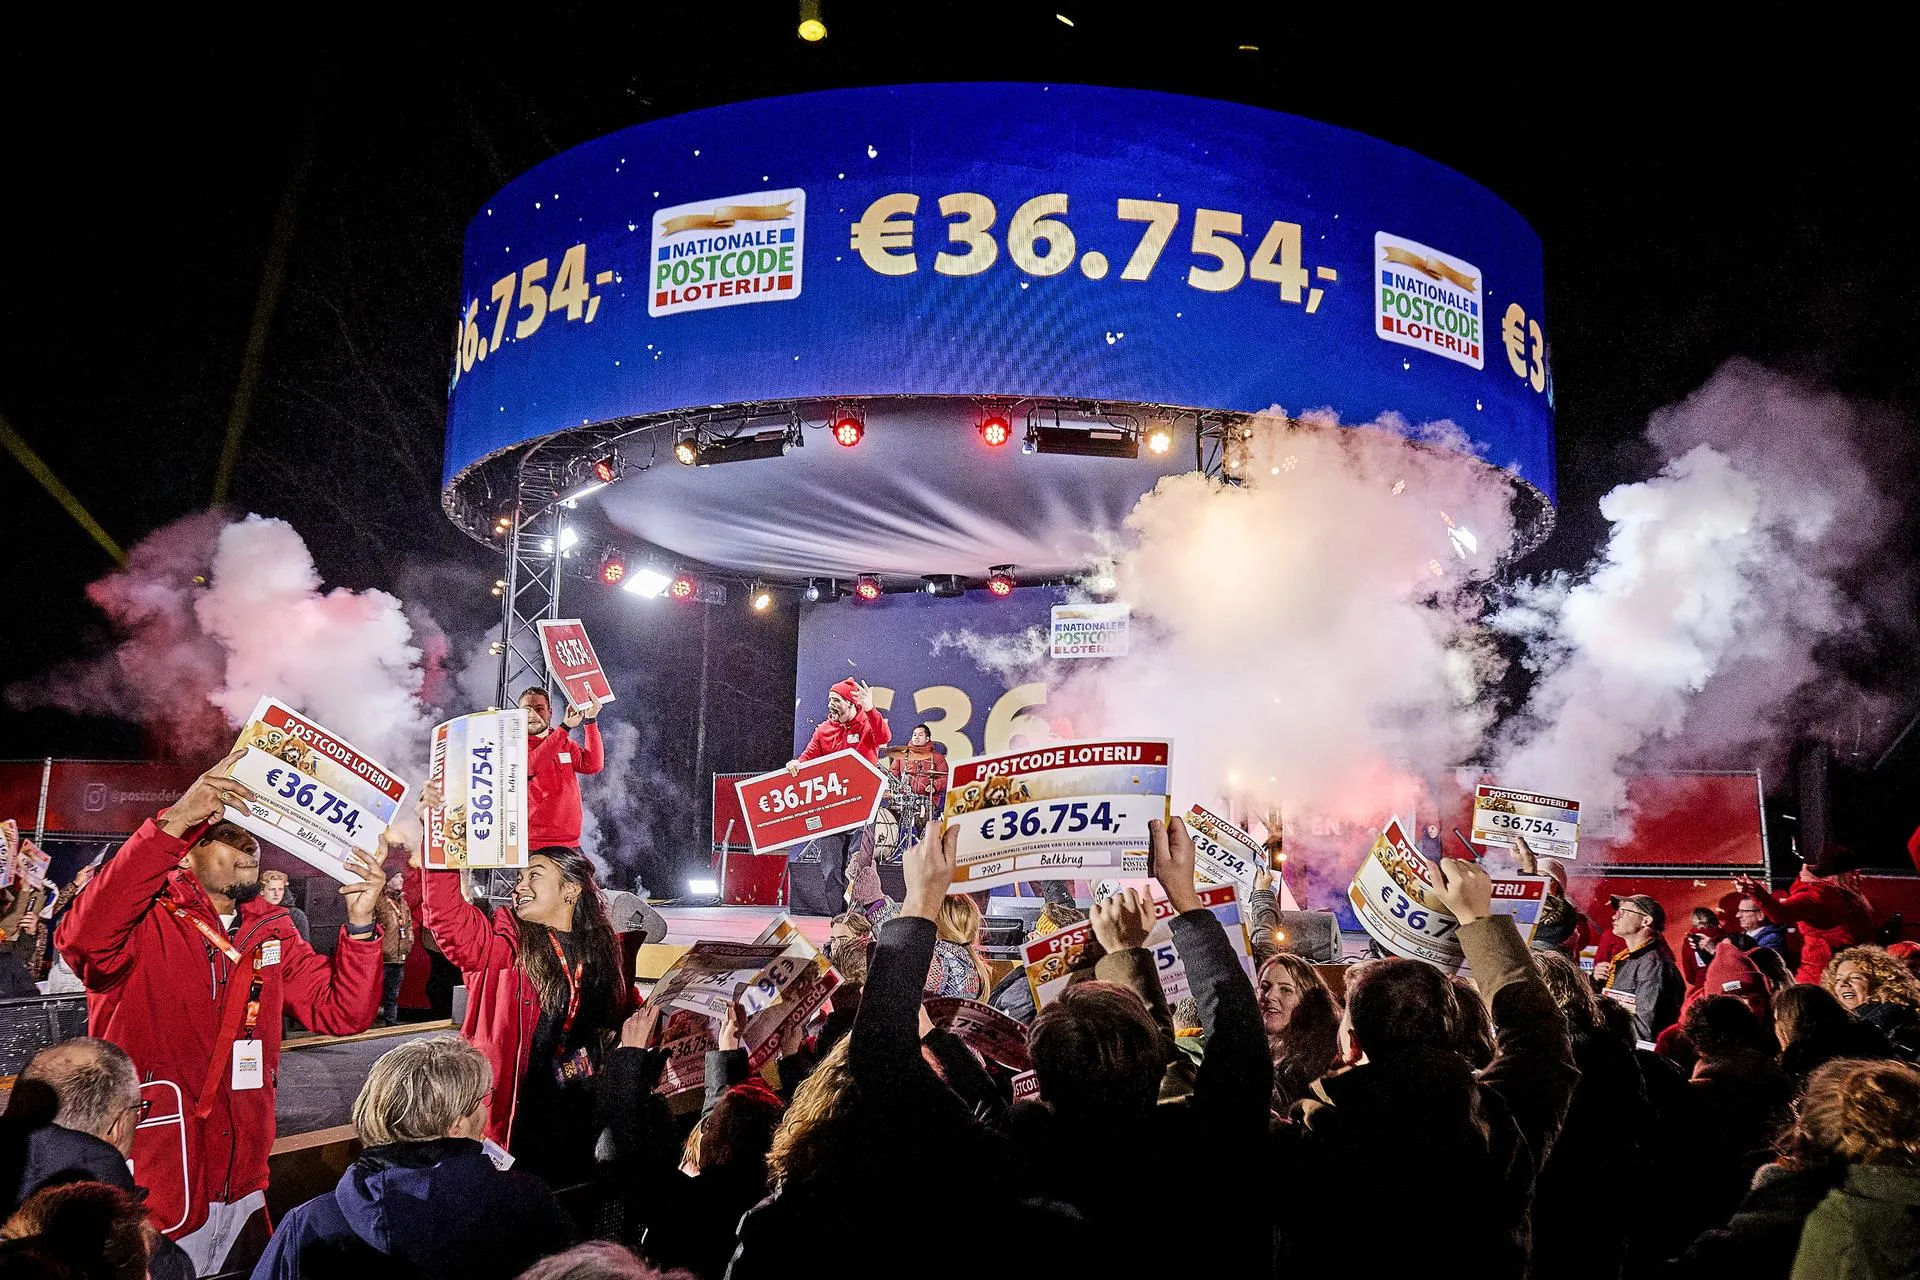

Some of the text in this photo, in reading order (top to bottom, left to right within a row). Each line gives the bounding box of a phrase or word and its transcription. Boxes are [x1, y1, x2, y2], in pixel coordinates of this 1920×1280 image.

[672, 229, 777, 258] NATIONALE
[656, 246, 794, 289] POSTCODE
[670, 276, 775, 304] LOTERIJ
[1395, 274, 1469, 312] NATIONALE
[1382, 288, 1479, 343] POSTCODE
[1396, 319, 1470, 355] LOTERIJ
[1502, 303, 1545, 393] €3
[1055, 631, 1107, 645] POSTCO
[1063, 622, 1116, 631] NATIONALE
[1063, 645, 1105, 654] LOTER
[284, 718, 393, 791] POSTCODE LOTERIJ
[976, 746, 1142, 779] POSTCODE LOTERIJ
[1489, 789, 1569, 808] POSTCODE LOTERIJ
[1200, 811, 1240, 837] POSTCODE
[1040, 852, 1084, 869] Balkbrug
